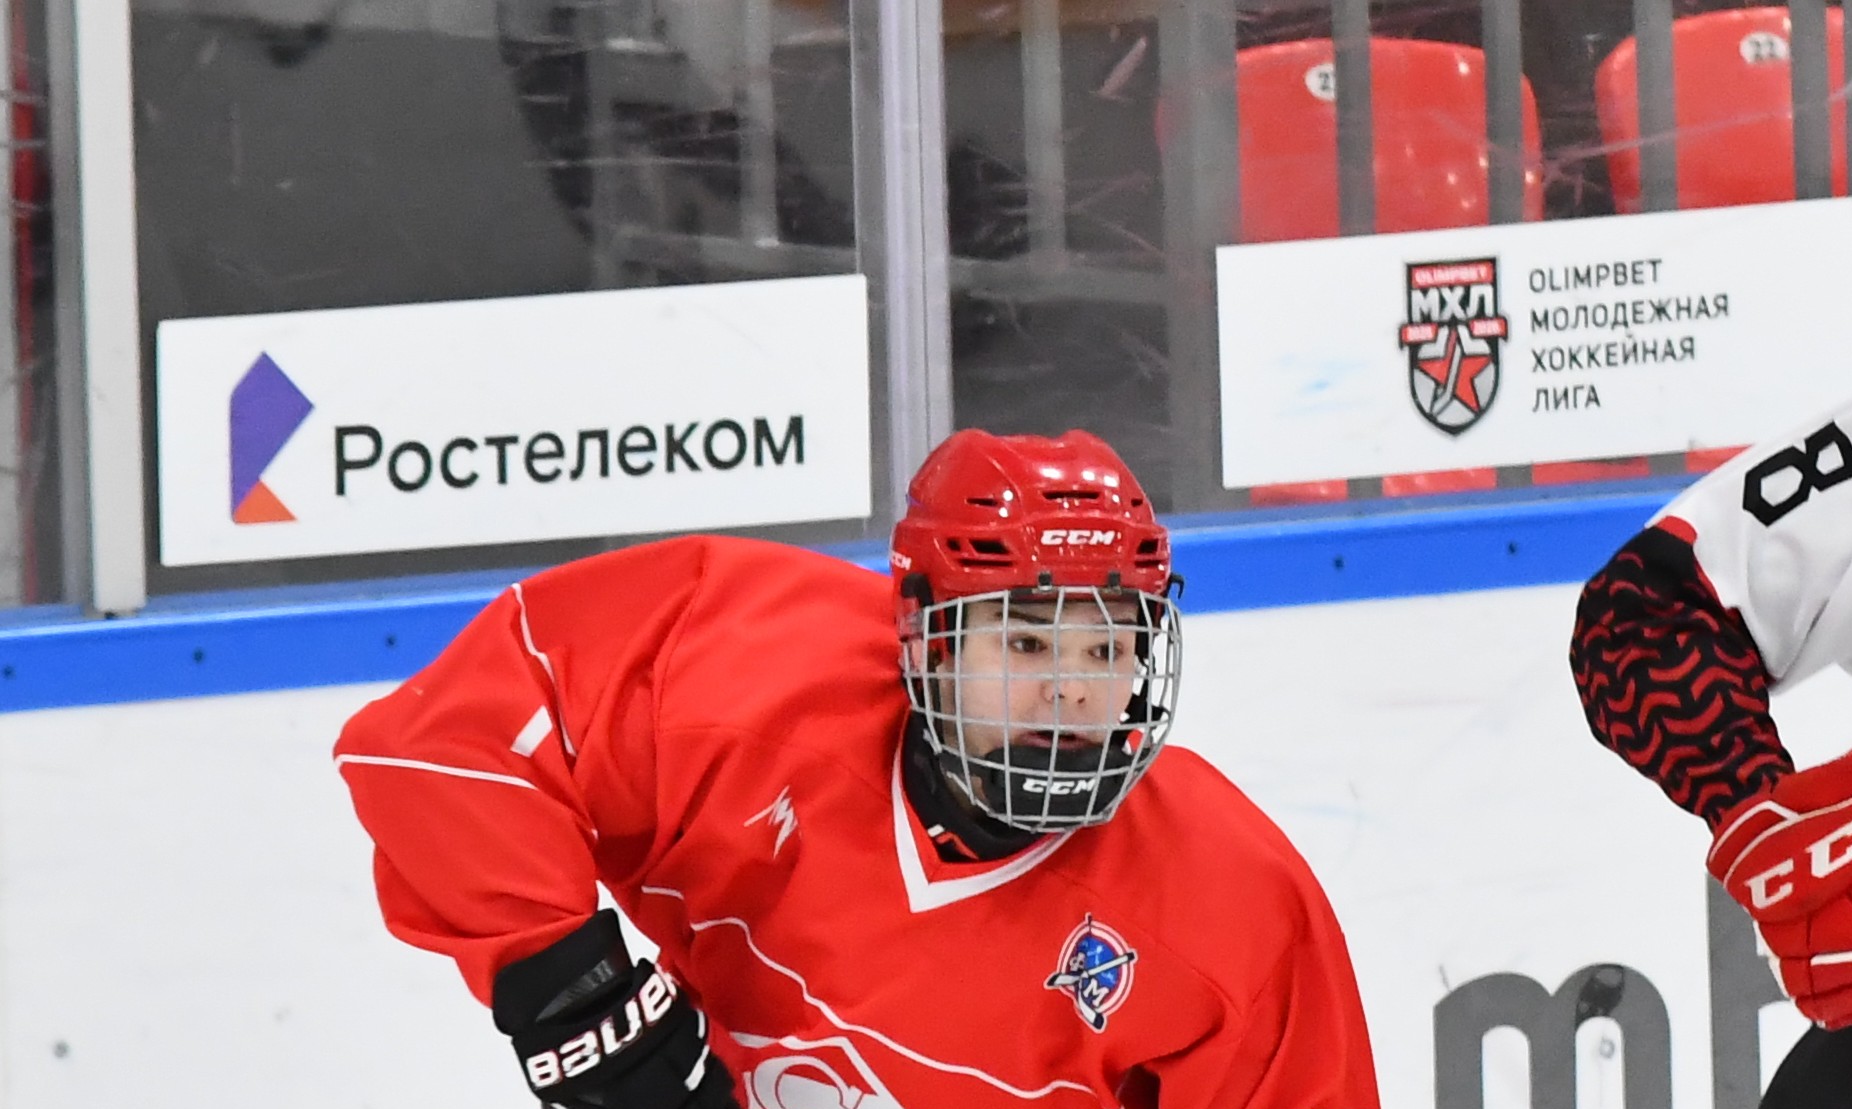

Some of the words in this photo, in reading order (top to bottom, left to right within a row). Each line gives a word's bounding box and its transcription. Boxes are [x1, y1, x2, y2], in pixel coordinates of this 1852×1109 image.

[1529, 259, 1663, 293] OLIMPBET
[1411, 281, 1494, 323] МХЛ
[1531, 293, 1729, 333] МОЛОДЕЖНАЯ
[1531, 332, 1696, 372] ХОККЕЙНАЯ
[1533, 384, 1601, 412] ЛИГА
[334, 415, 805, 497] Ростелеком
[1041, 528, 1123, 547] CCM
[1022, 777, 1098, 796] CCM
